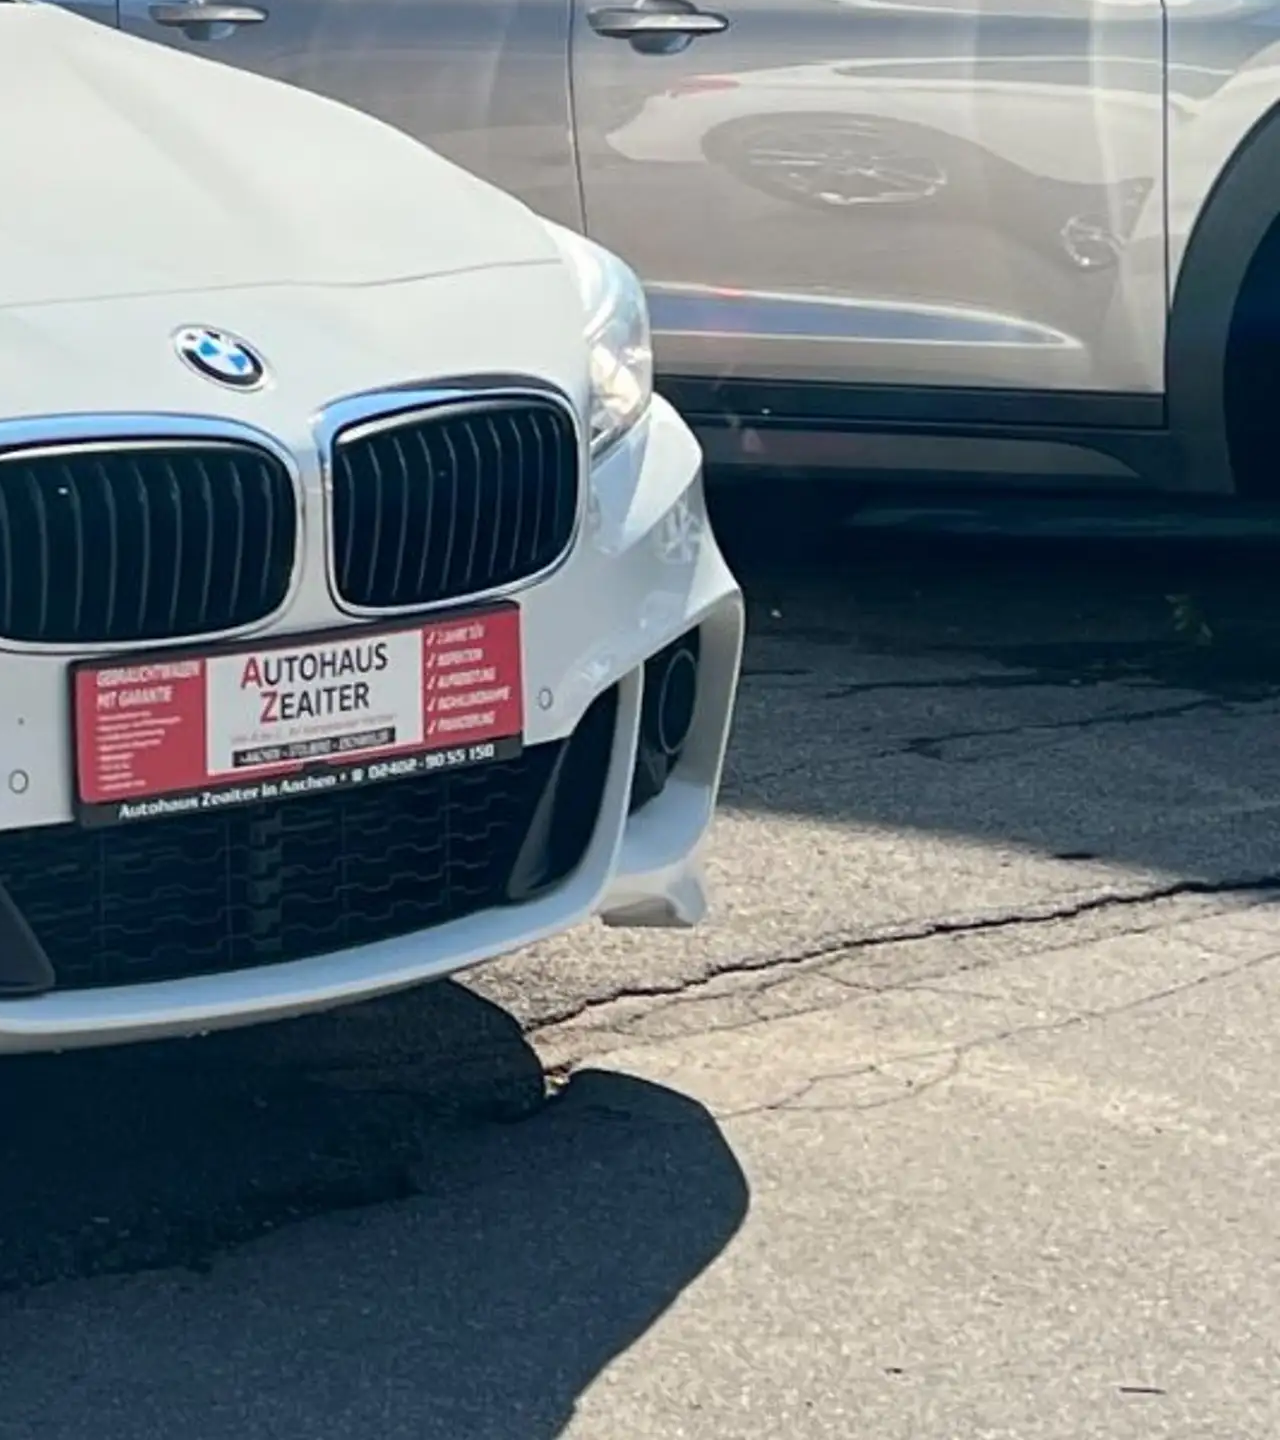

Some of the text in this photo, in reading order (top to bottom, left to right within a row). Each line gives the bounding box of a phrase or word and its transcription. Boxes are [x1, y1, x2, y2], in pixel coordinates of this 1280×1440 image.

[241, 642, 389, 690] AUTOHAUS
[259, 681, 371, 724] ZEAITER
[119, 795, 199, 820] Autohaus
[278, 775, 337, 795] Aachen
